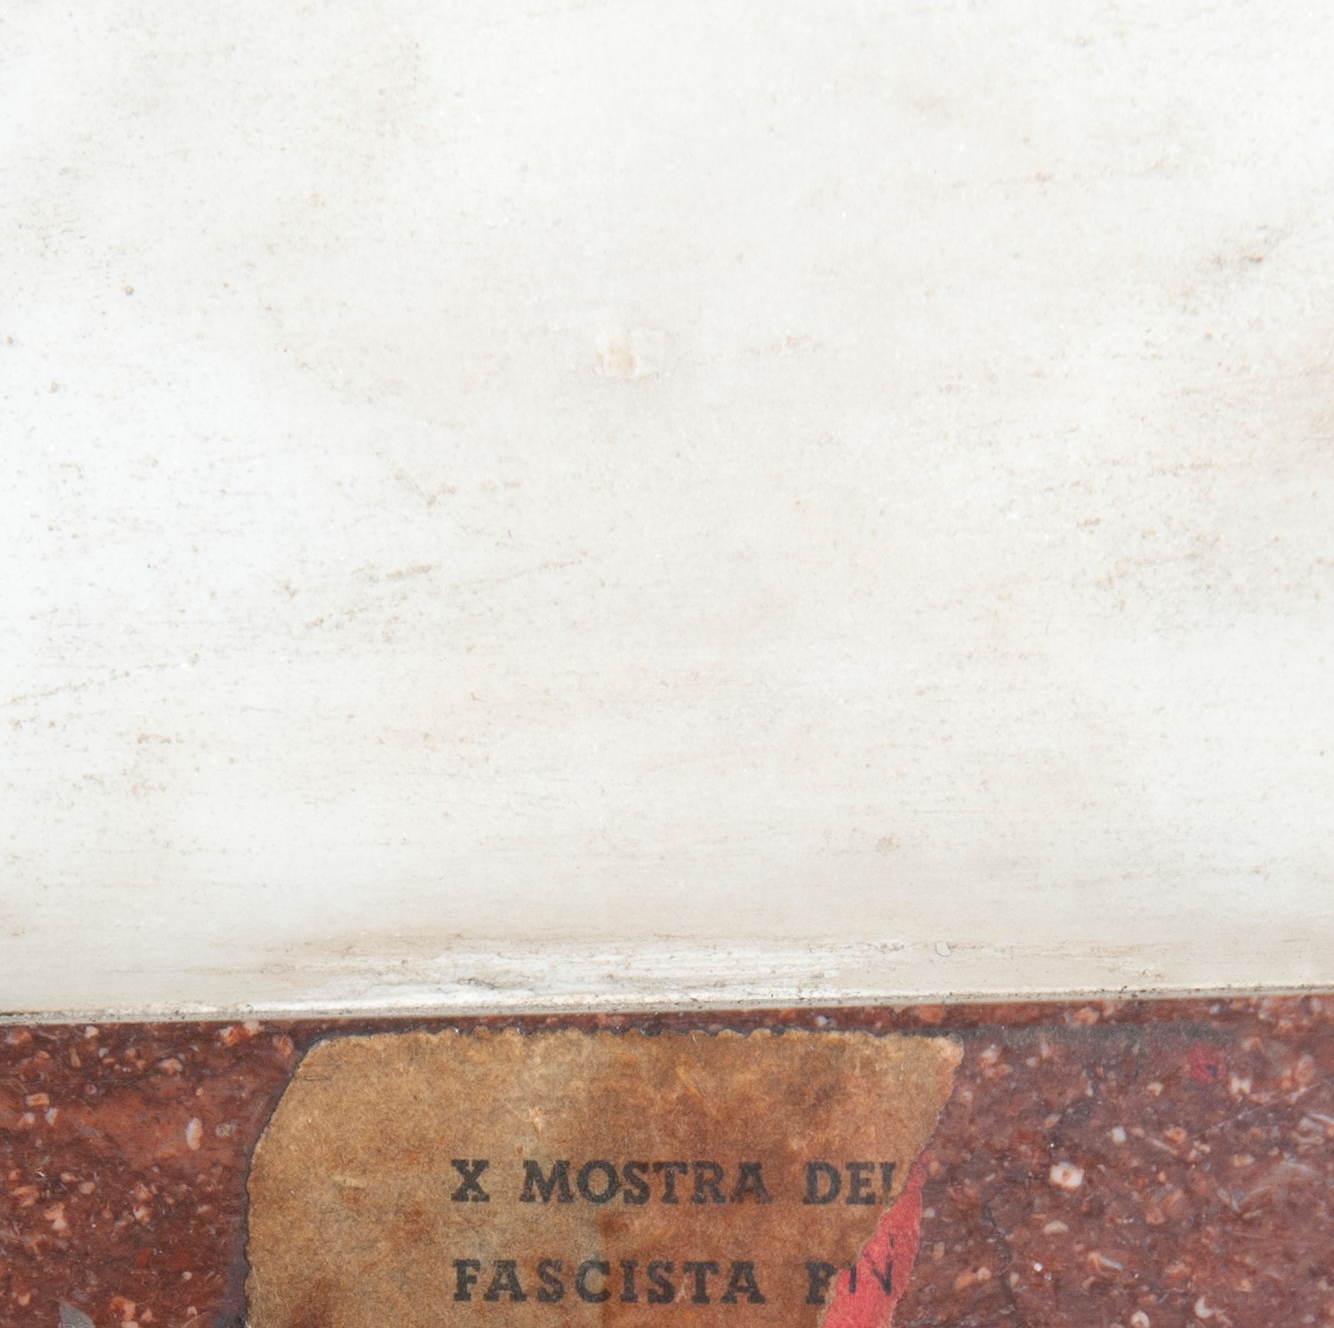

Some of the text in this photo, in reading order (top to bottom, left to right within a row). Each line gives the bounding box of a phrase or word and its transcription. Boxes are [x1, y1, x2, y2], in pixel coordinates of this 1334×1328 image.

[450, 1159, 490, 1202] X
[521, 1160, 772, 1204] MOSTRA
[452, 1259, 767, 1304] FASCISTA
